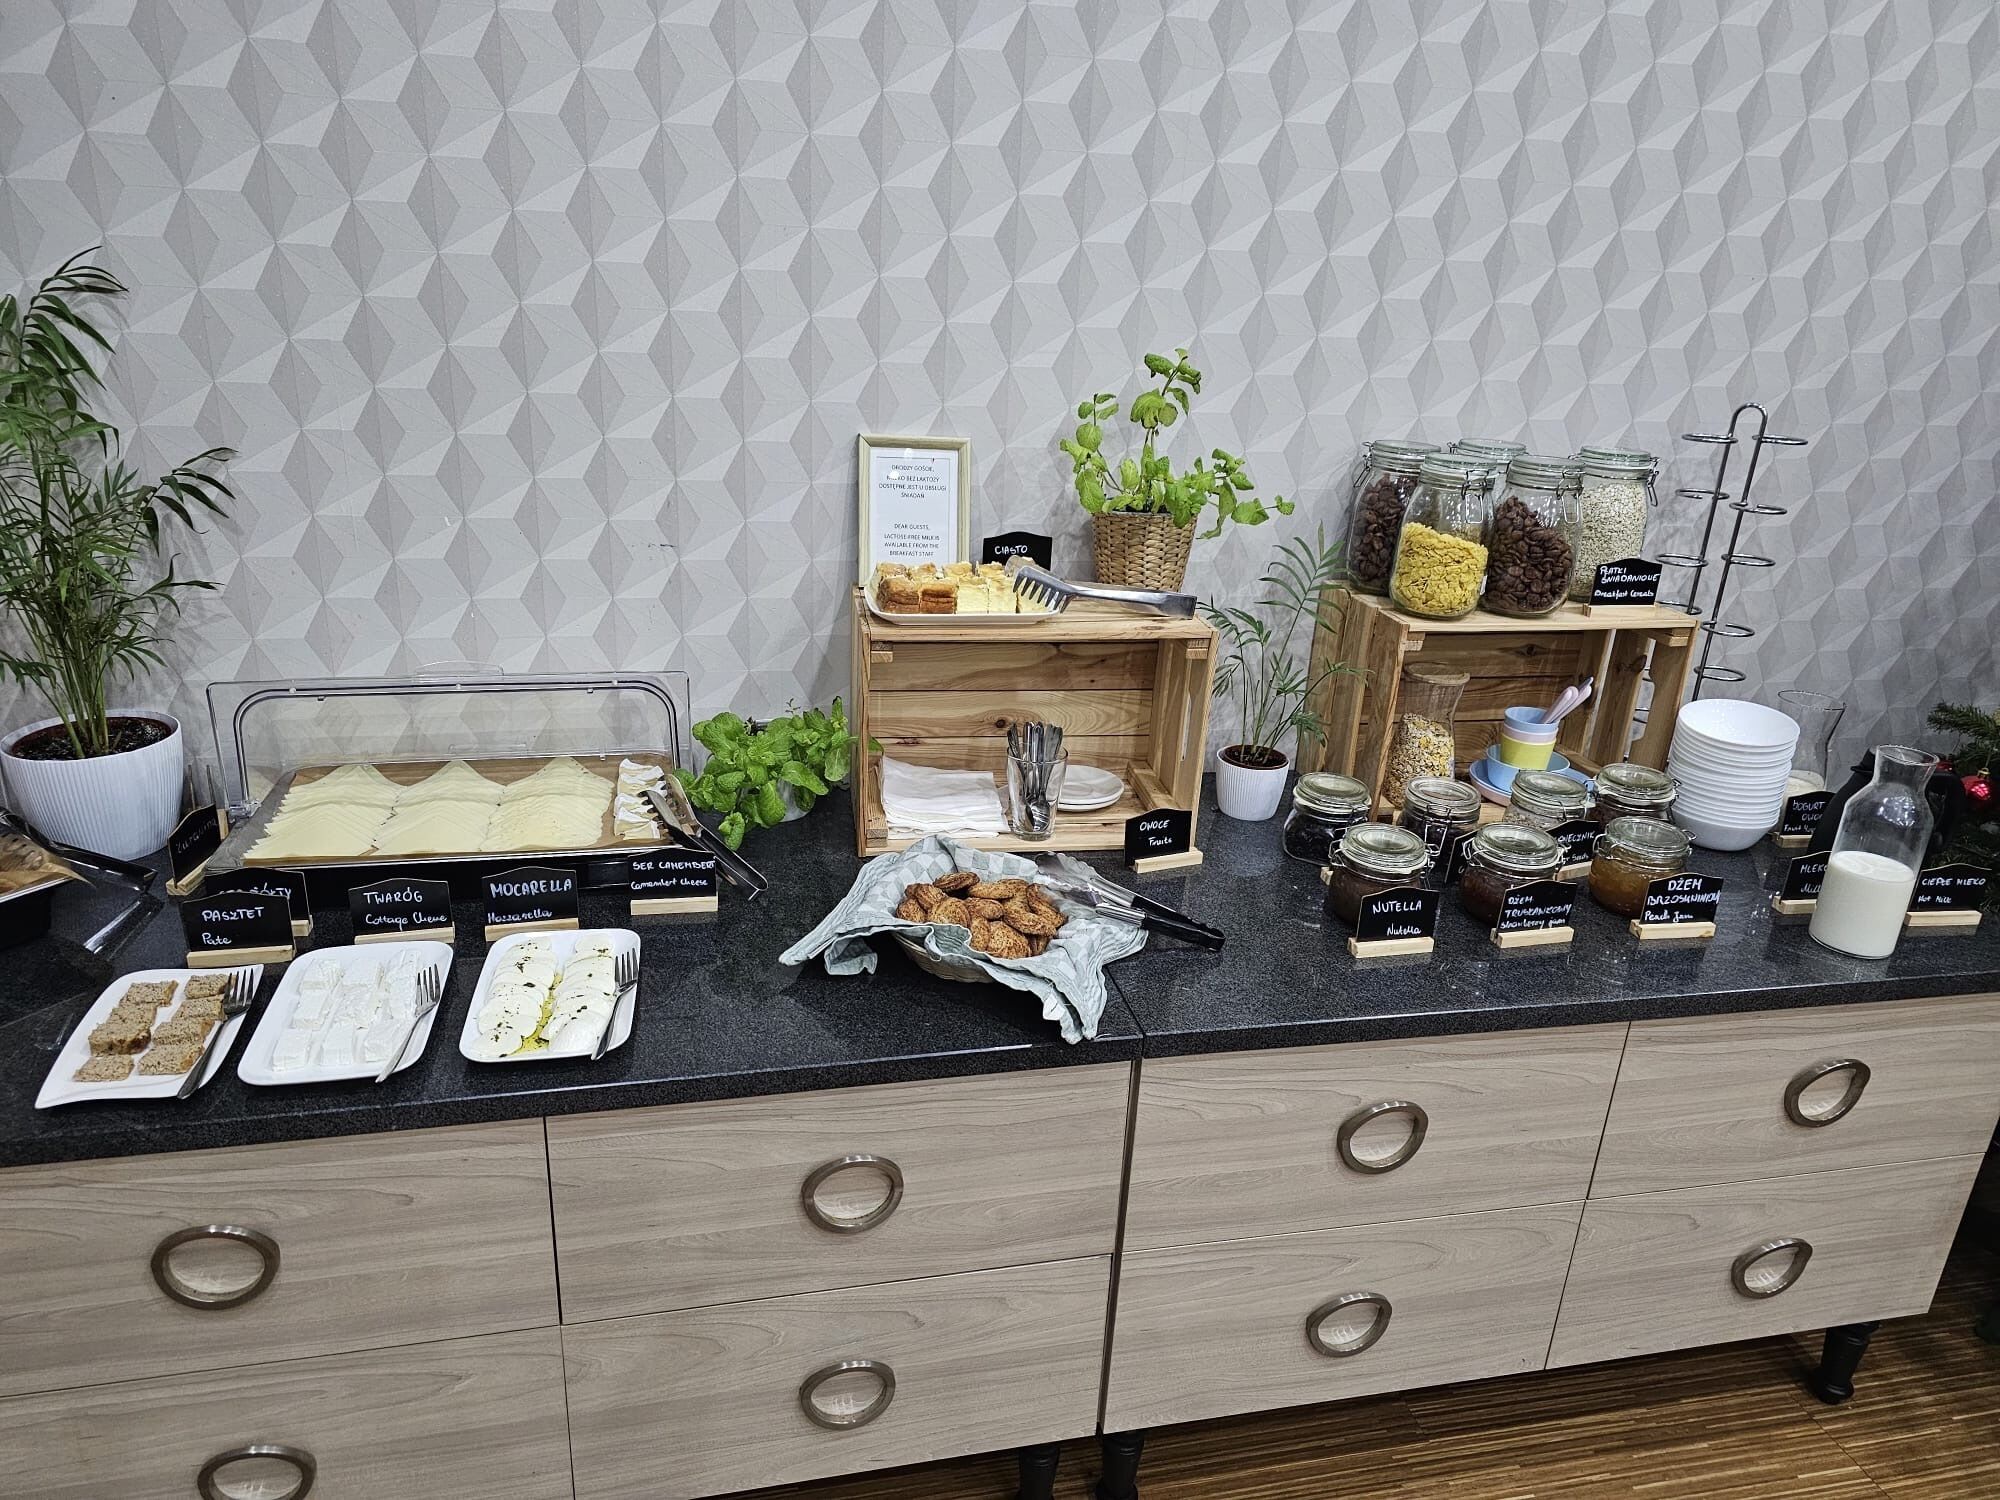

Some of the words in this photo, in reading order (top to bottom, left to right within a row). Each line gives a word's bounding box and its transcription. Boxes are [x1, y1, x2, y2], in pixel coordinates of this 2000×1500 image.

[994, 545, 1028, 554] CIASTO
[632, 862, 654, 870] SER
[658, 860, 716, 870] CAMEMBERT
[490, 879, 572, 898] MOCARELLA
[630, 878, 677, 890] Camembert
[1668, 878, 1702, 891] DŻEM
[1956, 878, 1986, 886] MLEKO
[363, 886, 422, 904] TWARÓG
[201, 906, 264, 922] PASZTET
[1372, 900, 1422, 915] NUTELLA
[366, 914, 408, 932] Cottage
[1386, 923, 1422, 936] Nutella
[201, 932, 232, 945] Pate
